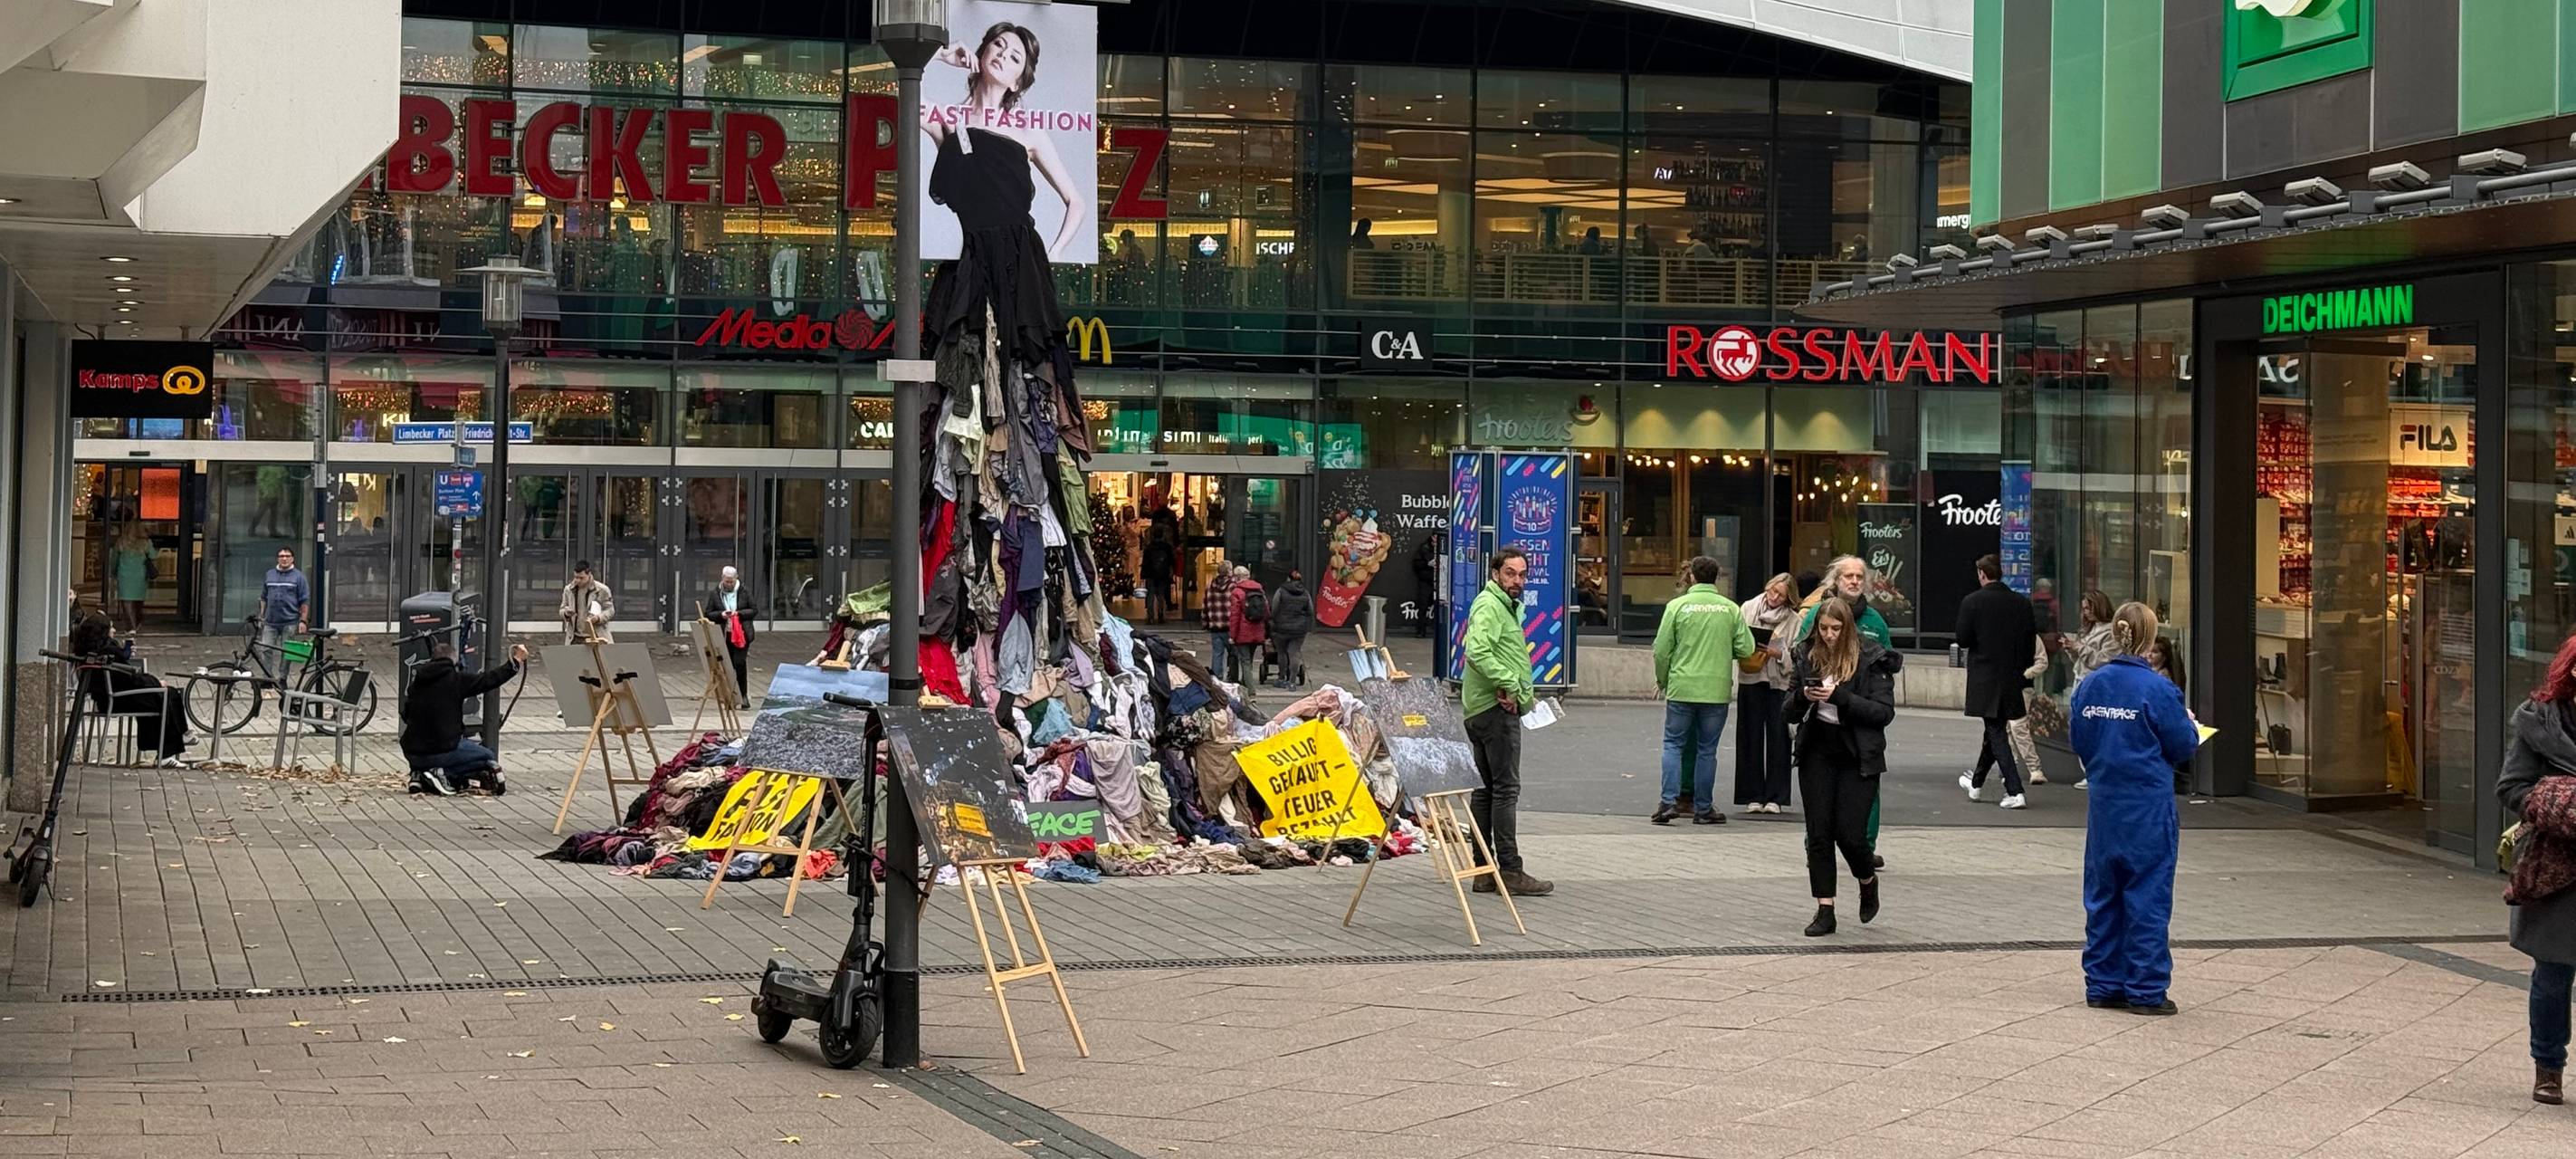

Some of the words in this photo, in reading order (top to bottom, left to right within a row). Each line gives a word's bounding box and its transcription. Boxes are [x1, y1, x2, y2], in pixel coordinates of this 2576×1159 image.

[921, 104, 973, 126] FAST
[984, 108, 1092, 132] FASHION
[359, 94, 787, 208] BECKER
[2263, 284, 2414, 334] DEICHMANN
[694, 306, 833, 350] Media
[1370, 330, 1425, 360] C&A
[1666, 324, 2003, 384] ROSSMAN
[79, 369, 160, 393] Kamps
[398, 428, 434, 439] Limbecker
[437, 428, 455, 439] Platz
[464, 427, 529, 439] Friedrich-t-Str.
[2399, 425, 2458, 451] FILA
[439, 474, 448, 485] U
[1396, 513, 1449, 529] Waffe
[1527, 523, 1537, 532] 10
[1859, 521, 1903, 539] Frooters
[1512, 539, 1550, 551] ESSEN
[1871, 547, 1890, 568] Eis
[2082, 705, 2140, 720] GREENPEACE
[1266, 736, 1317, 767] BILLIG
[1283, 789, 1338, 819] TEUER
